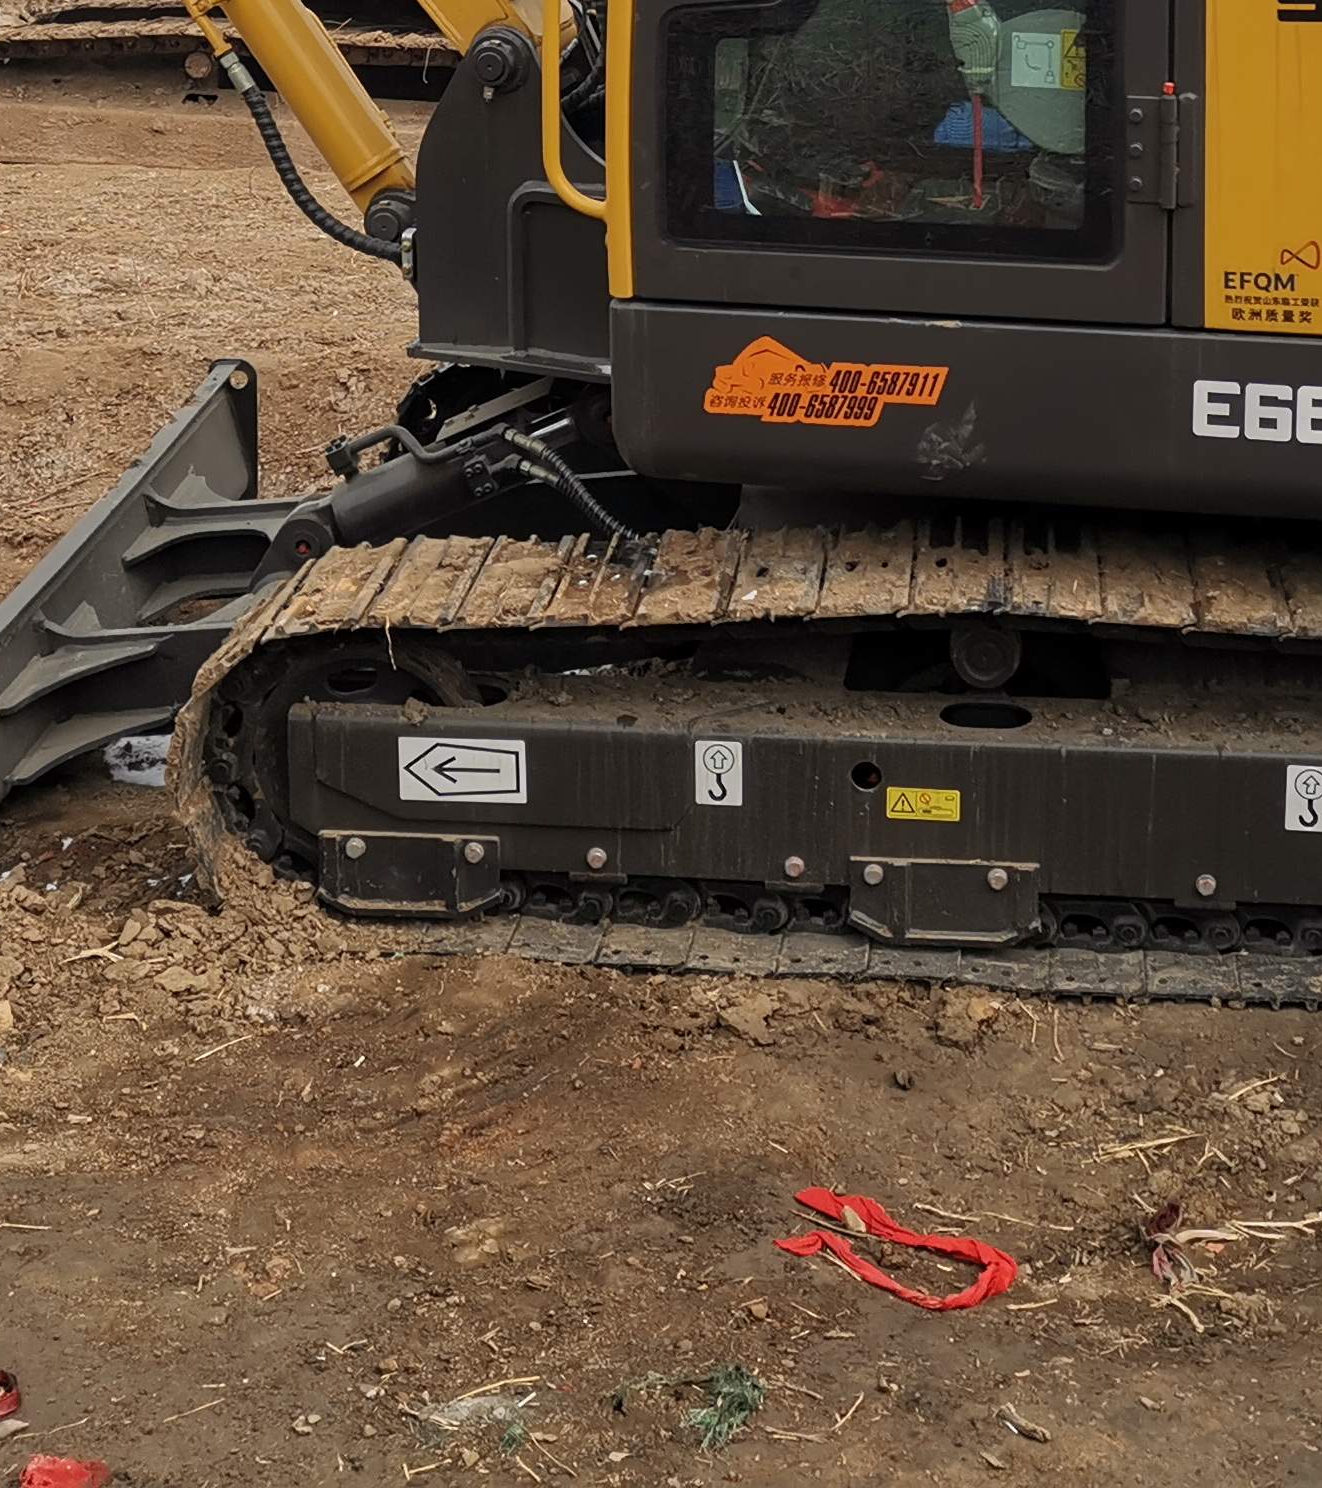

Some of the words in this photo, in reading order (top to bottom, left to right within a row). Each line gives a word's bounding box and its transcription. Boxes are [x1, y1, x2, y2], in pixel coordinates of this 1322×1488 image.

[1224, 272, 1295, 292] EFQM
[1232, 308, 1312, 323] 欧洲质量奖
[768, 372, 826, 388] 服务报修
[829, 370, 940, 397] 400-6587911
[709, 395, 766, 409] 咨询投诉
[767, 393, 878, 420] 400-6587999
